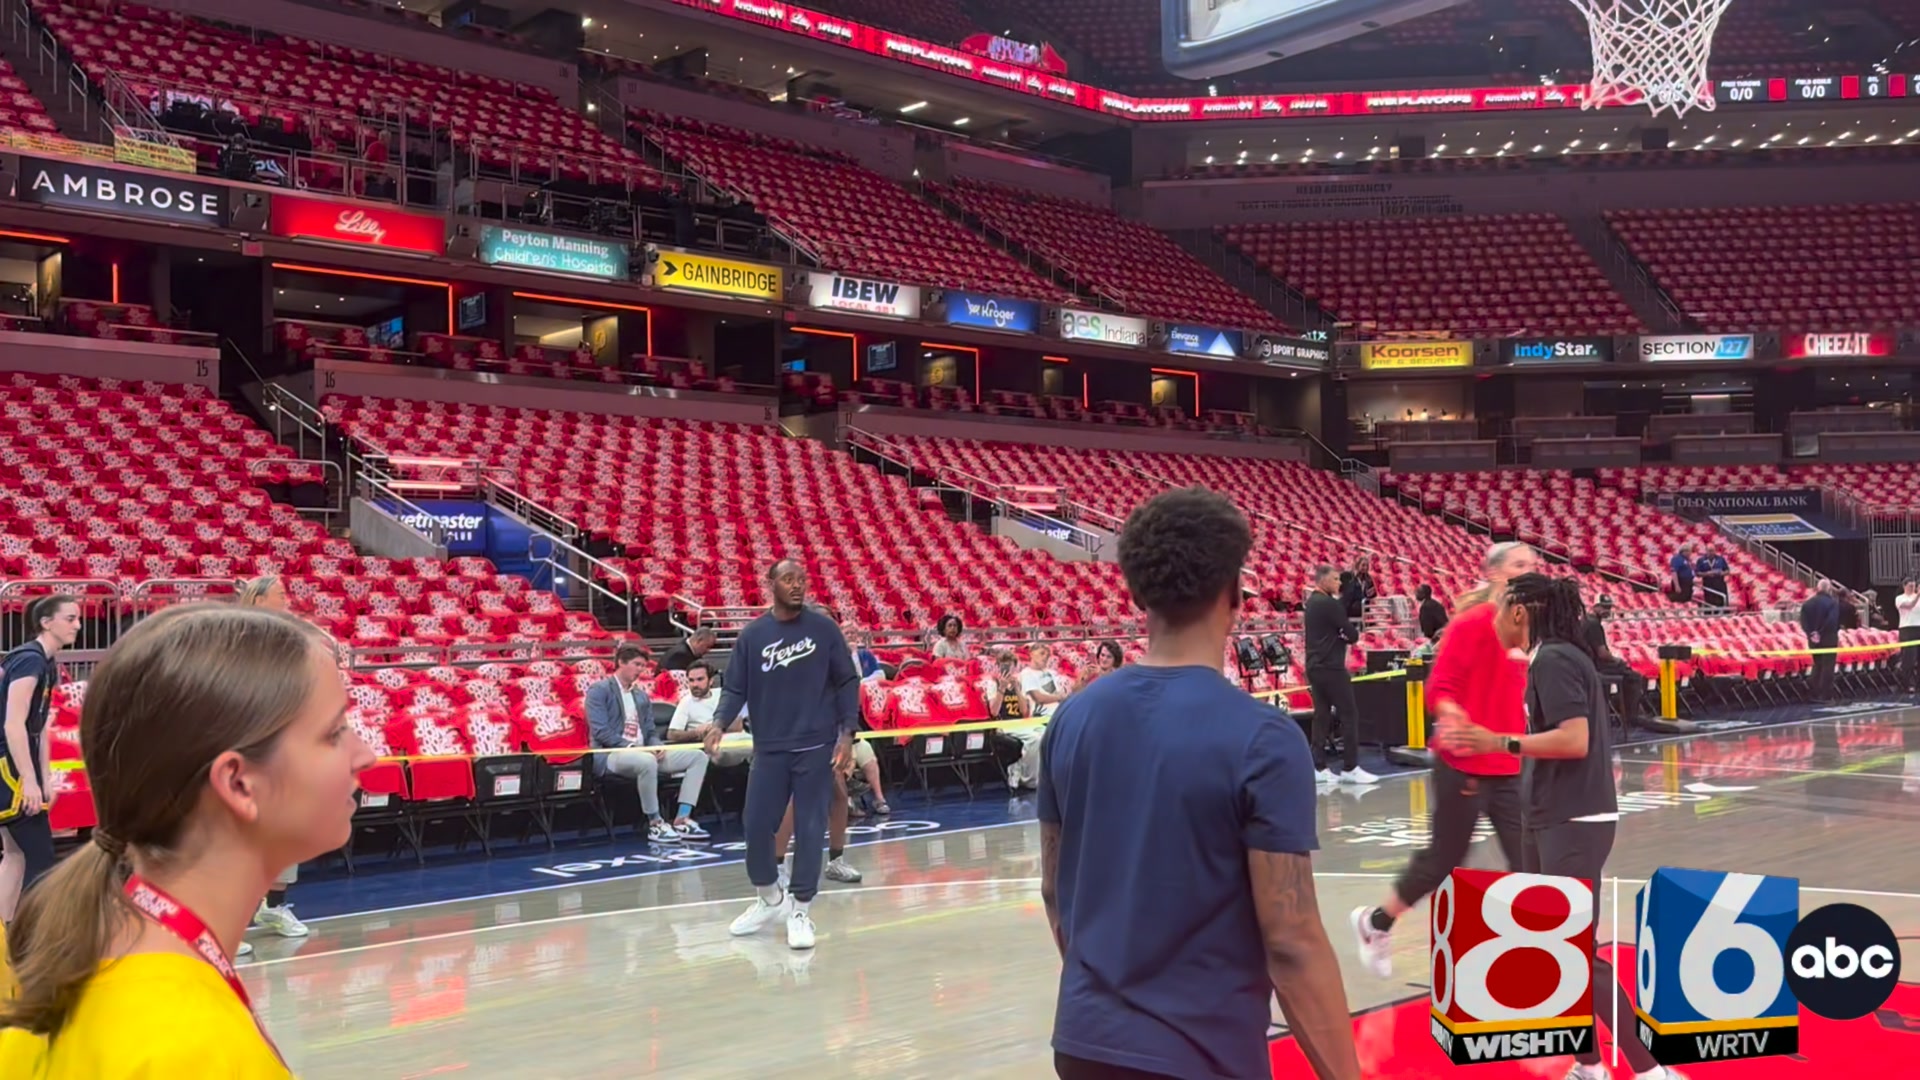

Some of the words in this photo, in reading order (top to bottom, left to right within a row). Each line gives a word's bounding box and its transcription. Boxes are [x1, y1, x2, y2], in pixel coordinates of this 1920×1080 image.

[1730, 88, 1753, 100] 0/0
[1802, 85, 1825, 98] 0/0
[32, 170, 218, 215] AMBROSE
[334, 210, 386, 244] Lilly
[502, 229, 549, 248] Peyton
[552, 236, 609, 258] Manning
[494, 246, 557, 268] Children's
[561, 253, 618, 275] Hospital
[683, 261, 777, 293] GAINBRIDGE
[832, 277, 900, 304] IBEW
[981, 300, 1016, 327] Kroger
[1062, 312, 1101, 338] aes
[1105, 324, 1145, 344] Indiana
[1273, 344, 1295, 356] SPORT
[1371, 345, 1460, 358] Koorsen
[1642, 341, 1716, 355] SECTION
[196, 360, 209, 377] 15
[324, 371, 336, 389] 16
[1677, 496, 1705, 508] OLD
[1707, 496, 1771, 508] NATIONAL
[1773, 495, 1808, 507] BANK
[762, 636, 816, 673] Fever
